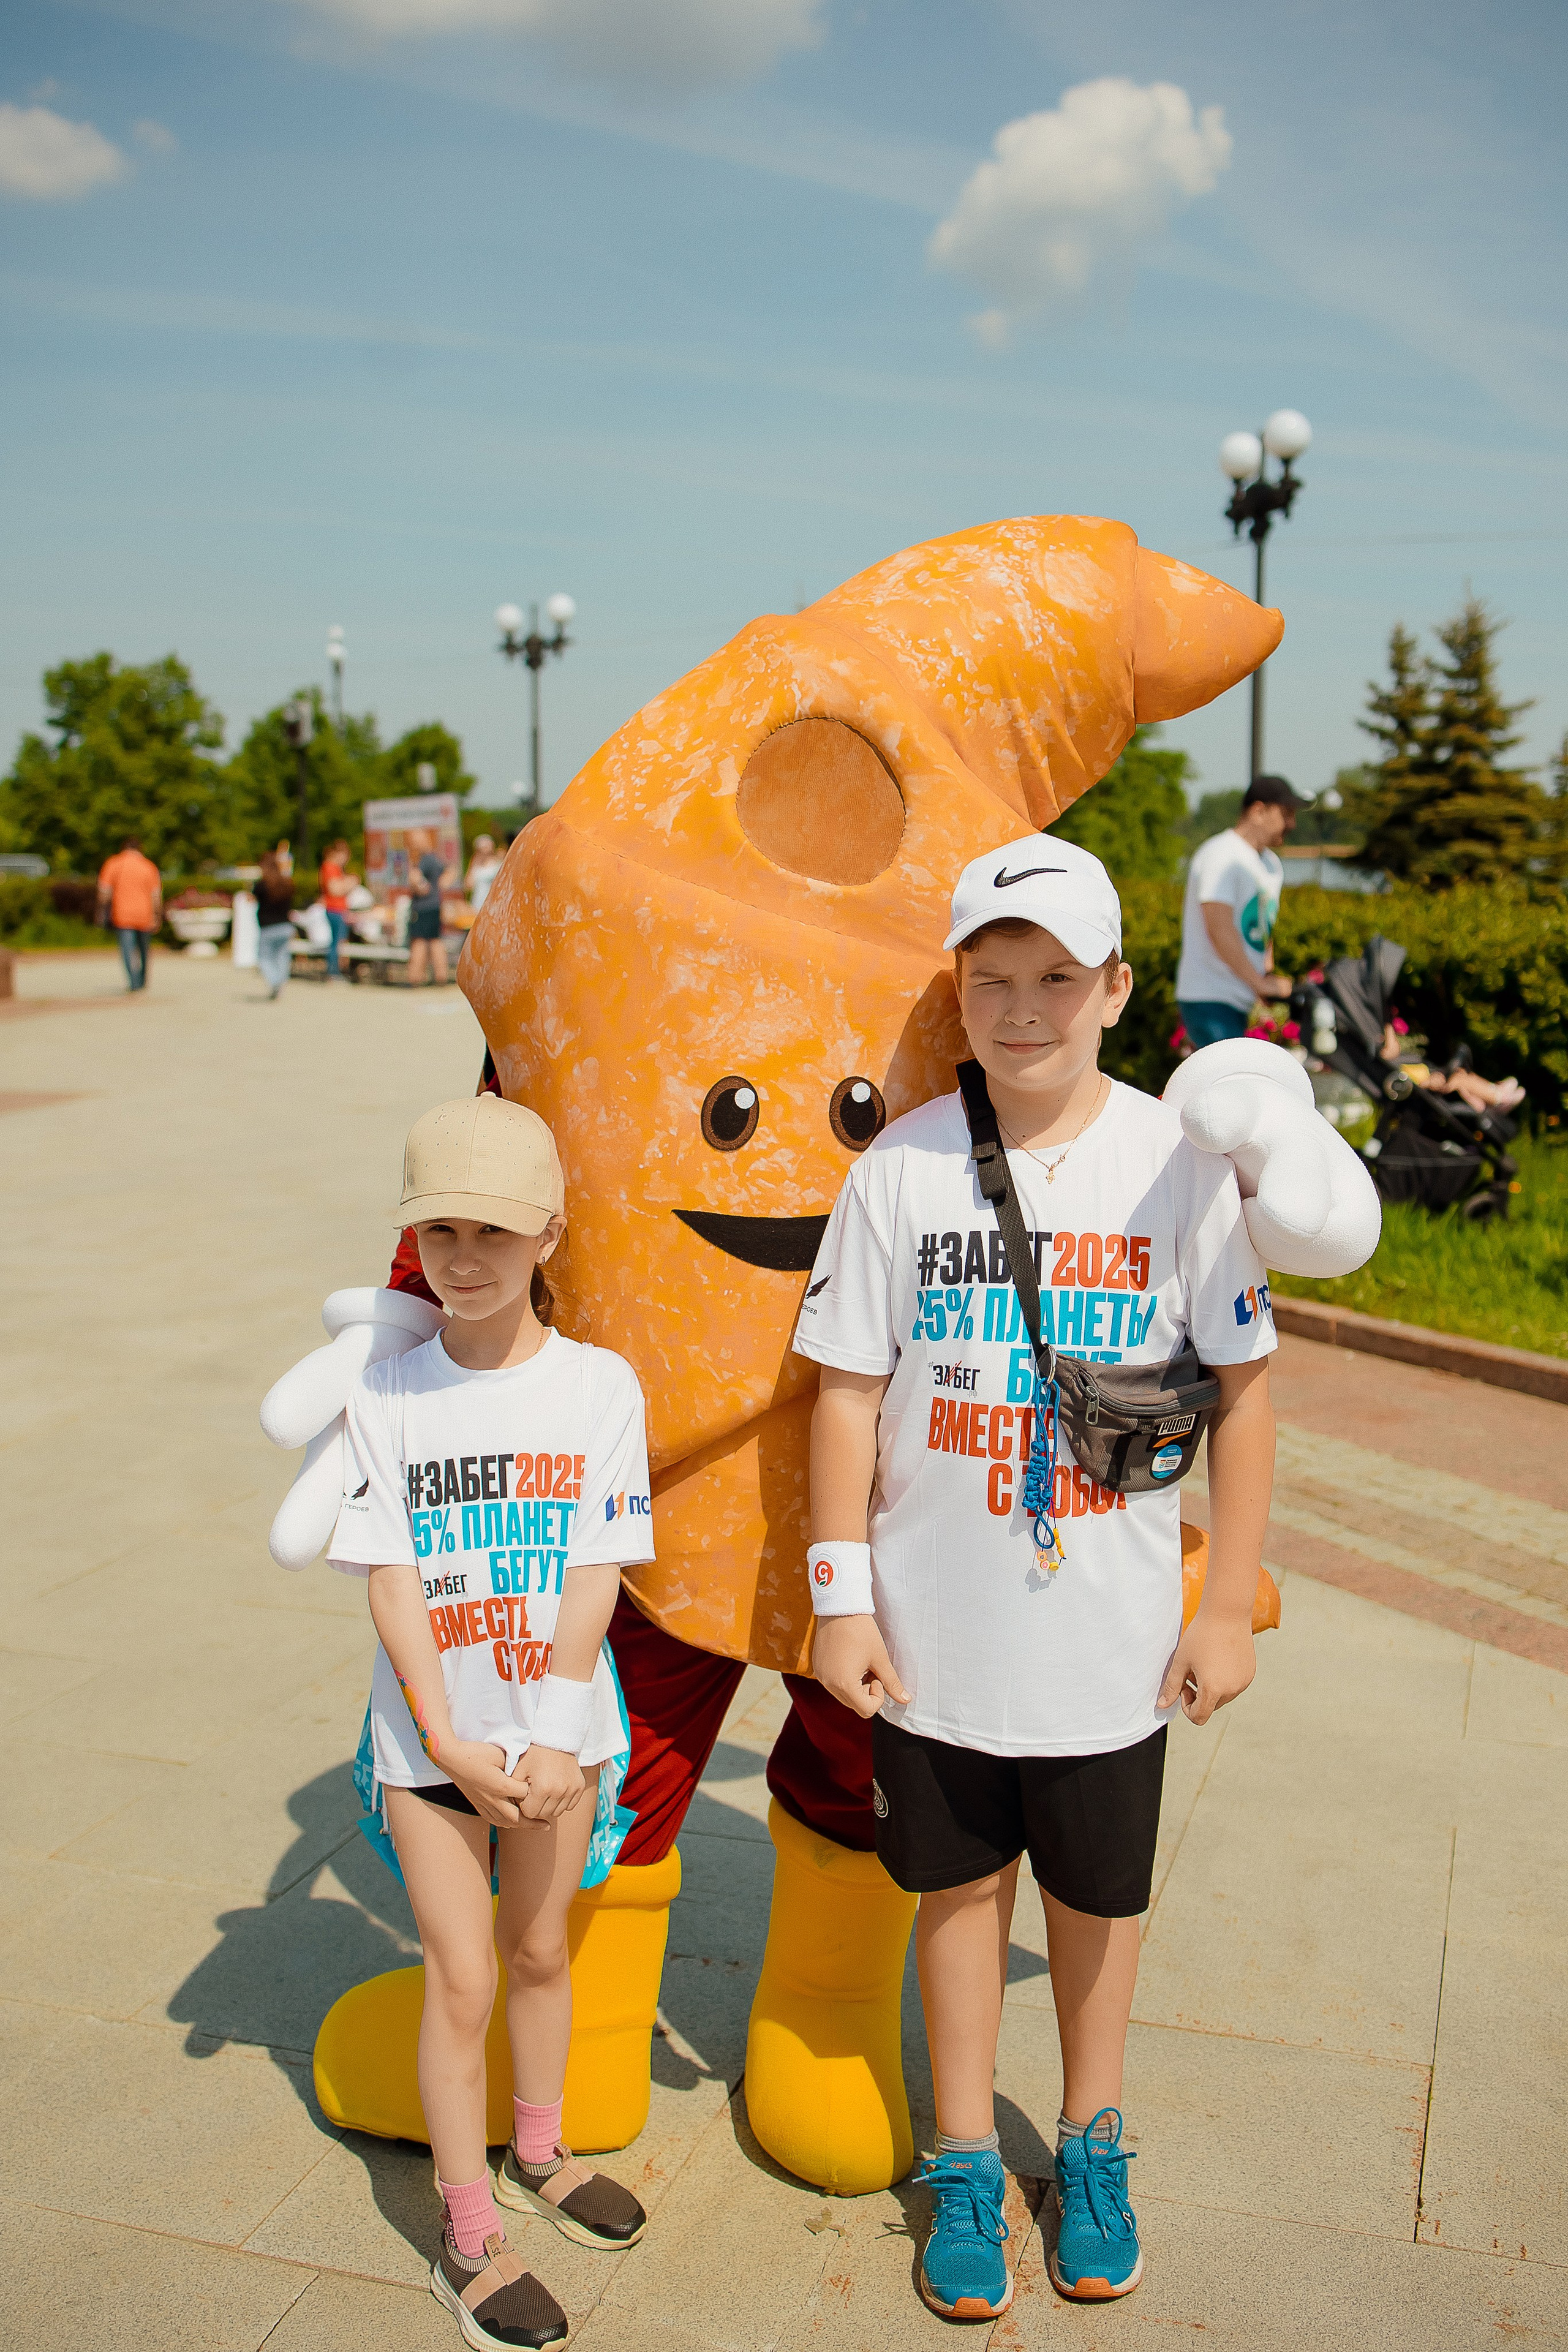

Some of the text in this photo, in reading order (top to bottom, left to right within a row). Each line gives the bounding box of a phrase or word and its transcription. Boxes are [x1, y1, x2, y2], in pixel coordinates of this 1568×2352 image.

[1157, 1414, 1196, 1436] PUMA
[987, 1463, 1013, 1517] С
[462, 1501, 579, 1551] ПЛАНЕТ
[489, 1549, 568, 1595] БЕГУТ
[493, 1640, 512, 1682] С
